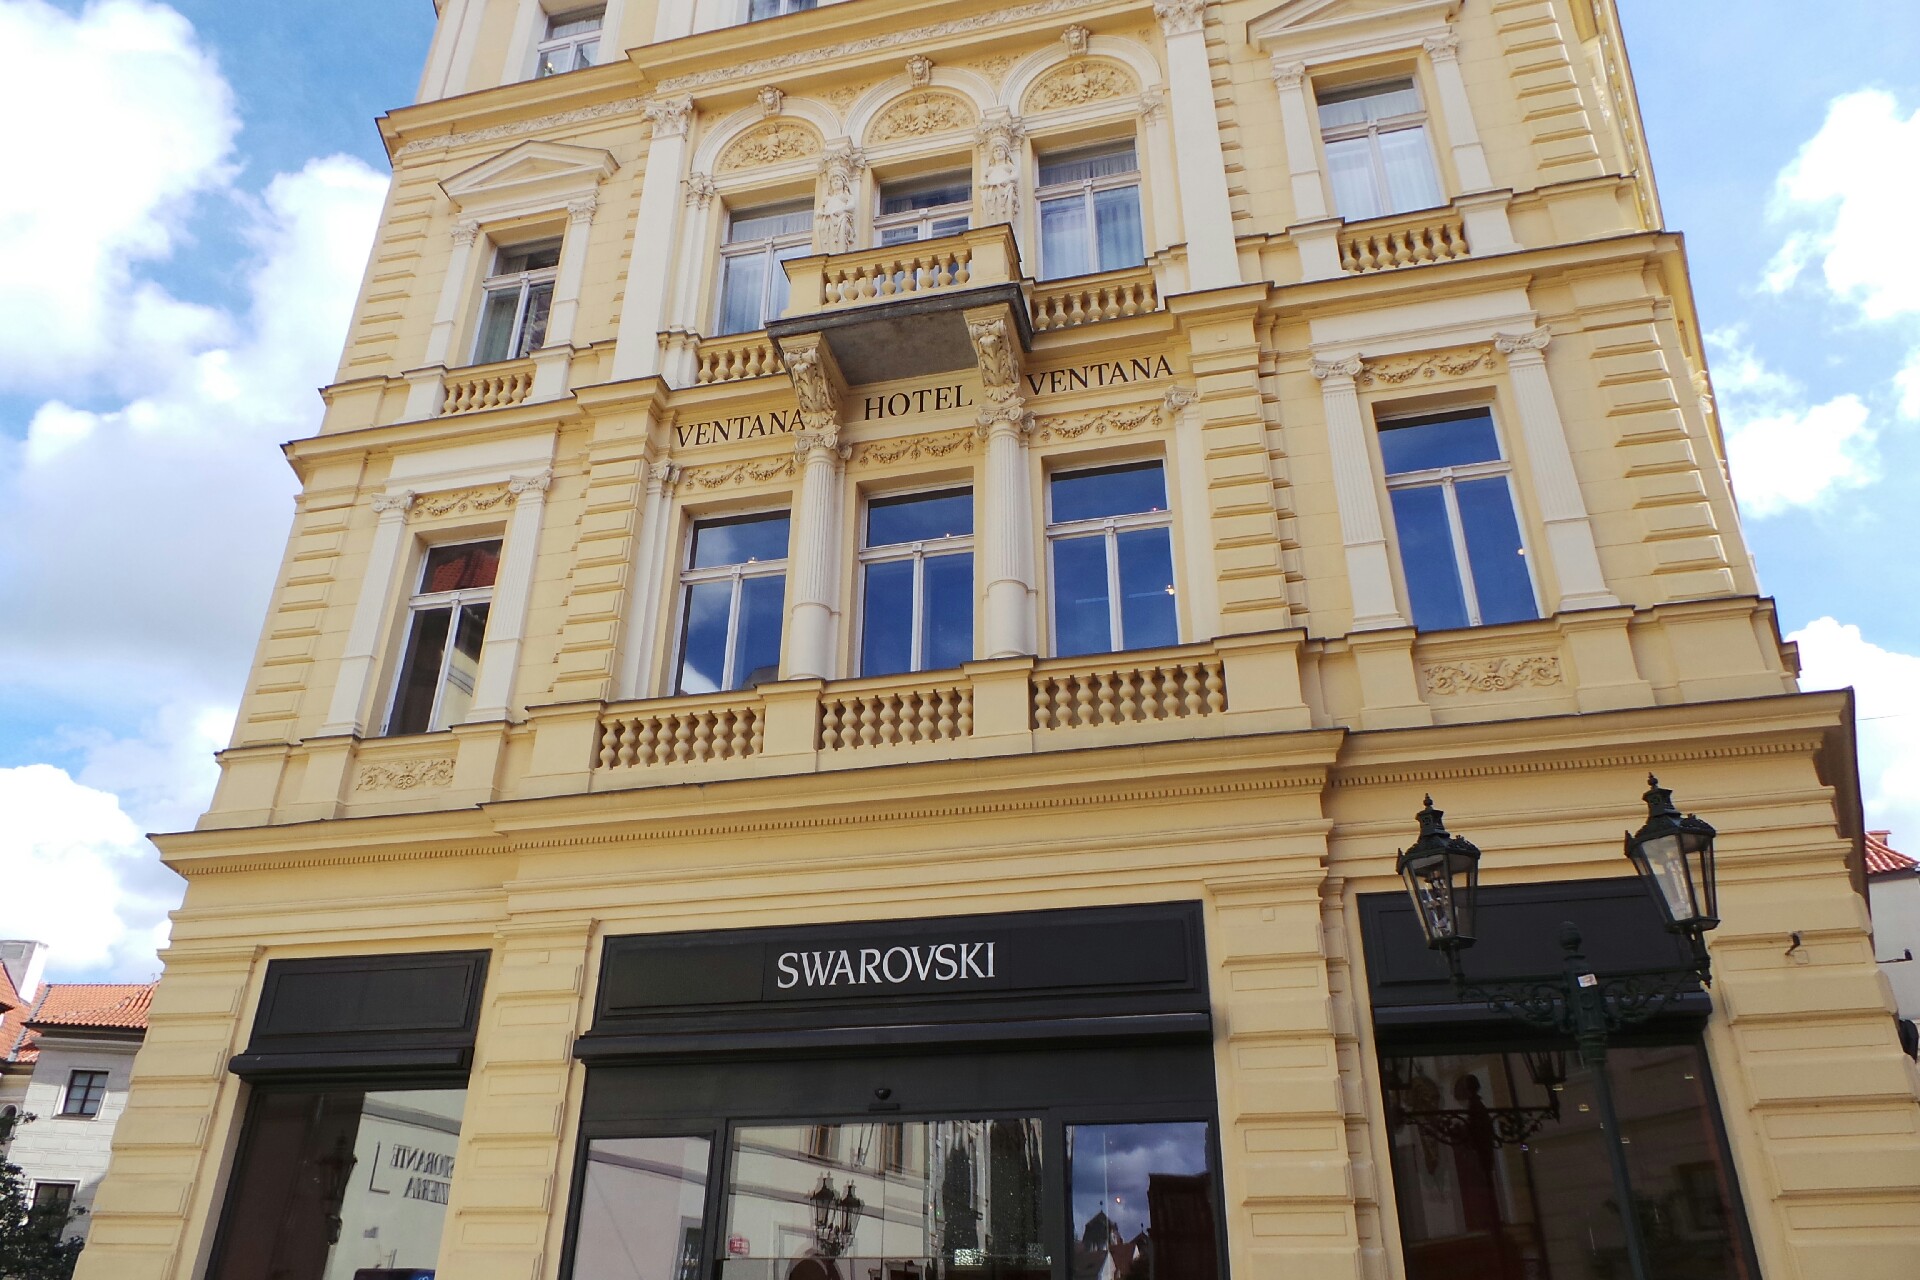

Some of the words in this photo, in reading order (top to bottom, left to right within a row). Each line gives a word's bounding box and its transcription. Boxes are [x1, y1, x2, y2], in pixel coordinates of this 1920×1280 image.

[1025, 354, 1173, 396] VENTANA
[864, 384, 973, 420] HOTEL
[676, 408, 806, 447] VENTANA
[777, 941, 996, 989] SWAROVSKI
